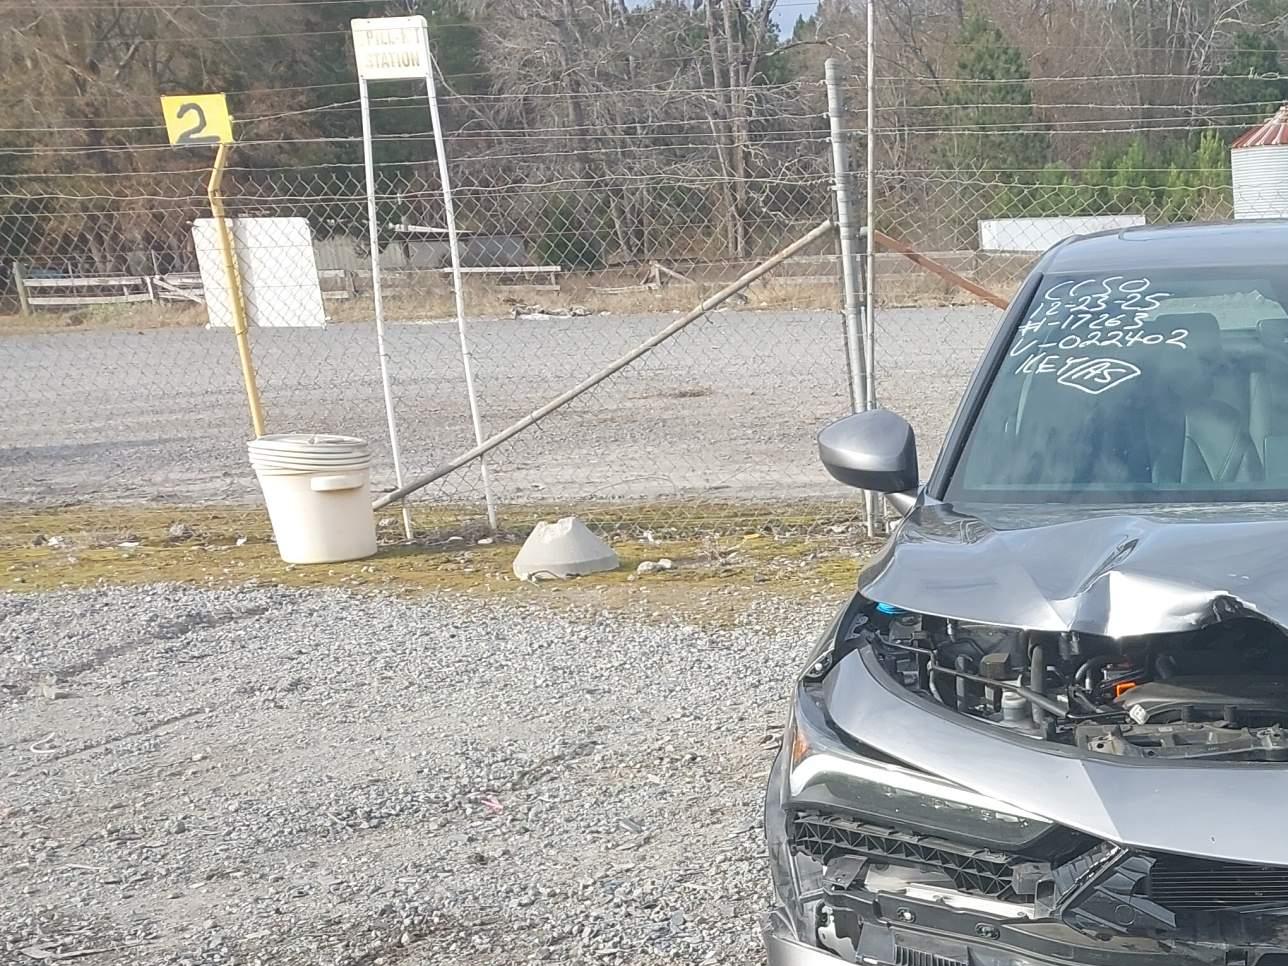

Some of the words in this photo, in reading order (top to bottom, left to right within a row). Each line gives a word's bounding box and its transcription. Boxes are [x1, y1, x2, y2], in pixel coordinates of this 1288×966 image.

[364, 51, 421, 68] STATION
[175, 103, 221, 143] 2
[1029, 293, 1171, 319] 12-23-25
